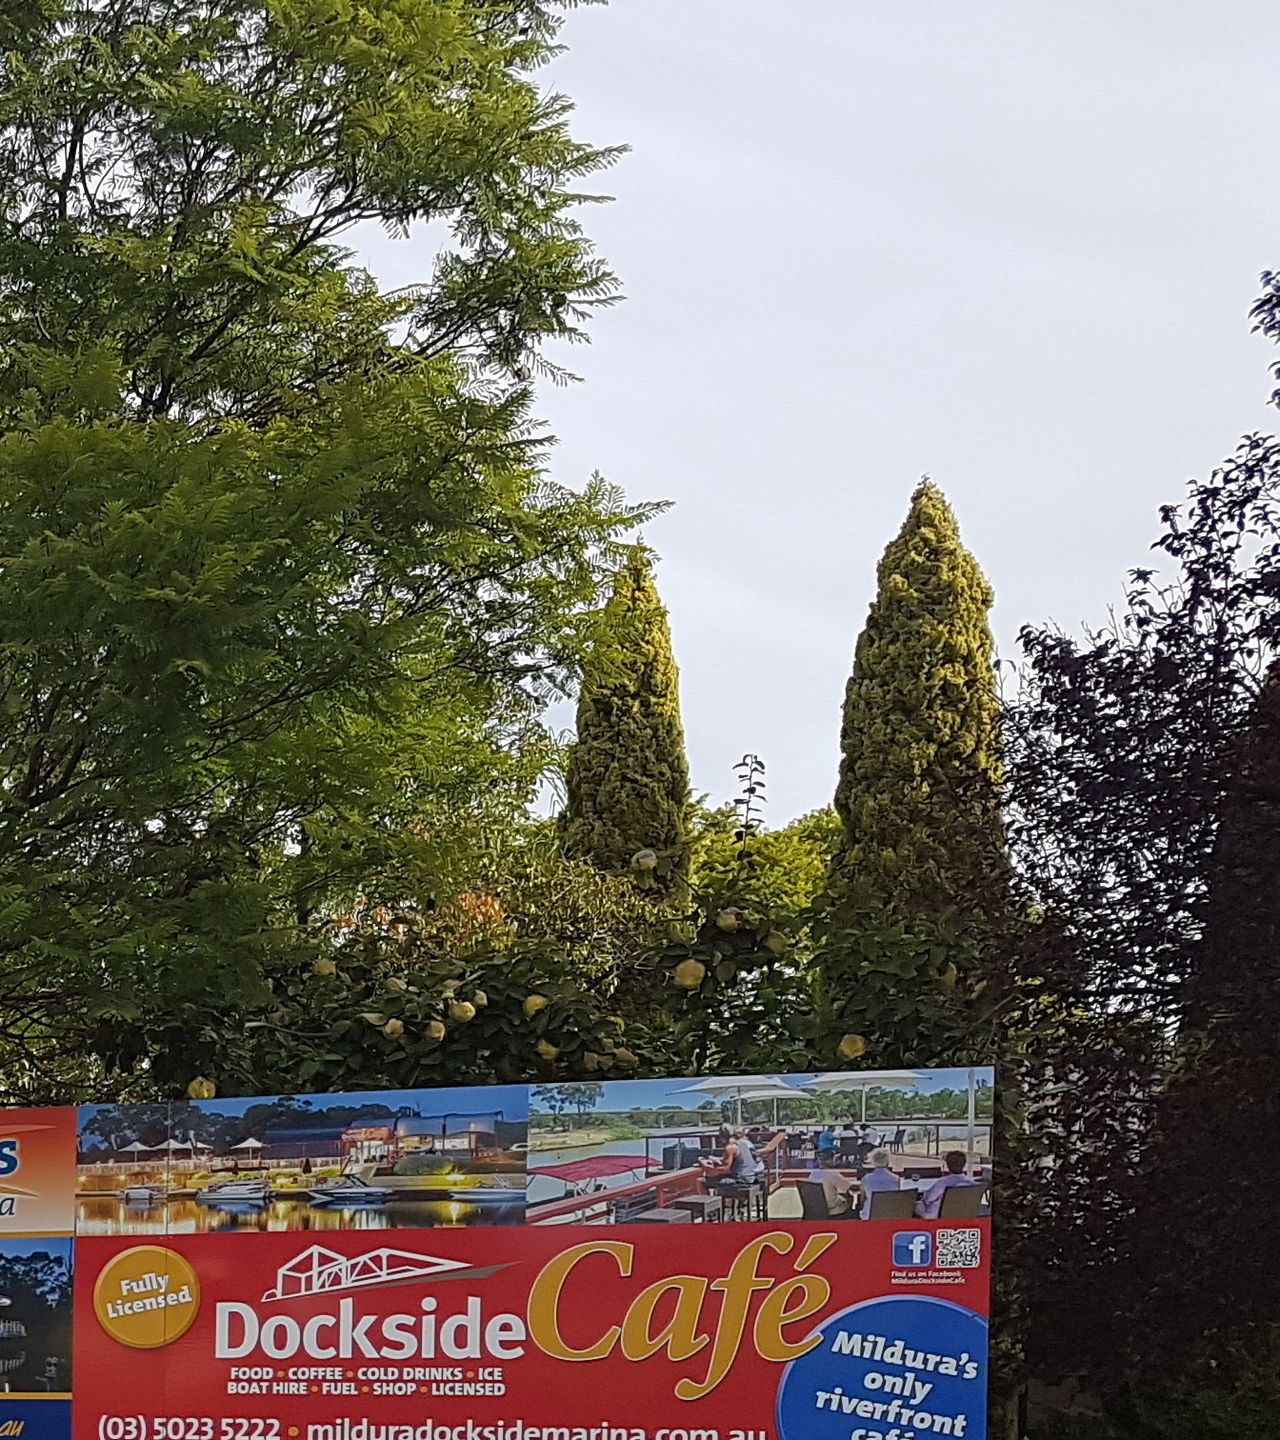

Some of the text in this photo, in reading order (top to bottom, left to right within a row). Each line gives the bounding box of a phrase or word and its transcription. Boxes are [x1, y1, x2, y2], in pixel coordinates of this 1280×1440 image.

[120, 1272, 169, 1296] Fully
[106, 1285, 193, 1319] Licensed
[214, 1230, 838, 1401] Dockside Café
[831, 1331, 978, 1379] Mildura's
[227, 1382, 506, 1396] BOAT HIRE FUEL SHOP LICENSED
[230, 1367, 503, 1381] FOOD COFFEE COLD DRINKS ICE
[863, 1371, 933, 1405] only
[153, 1417, 214, 1440] 5023
[815, 1387, 967, 1437] riverfront
